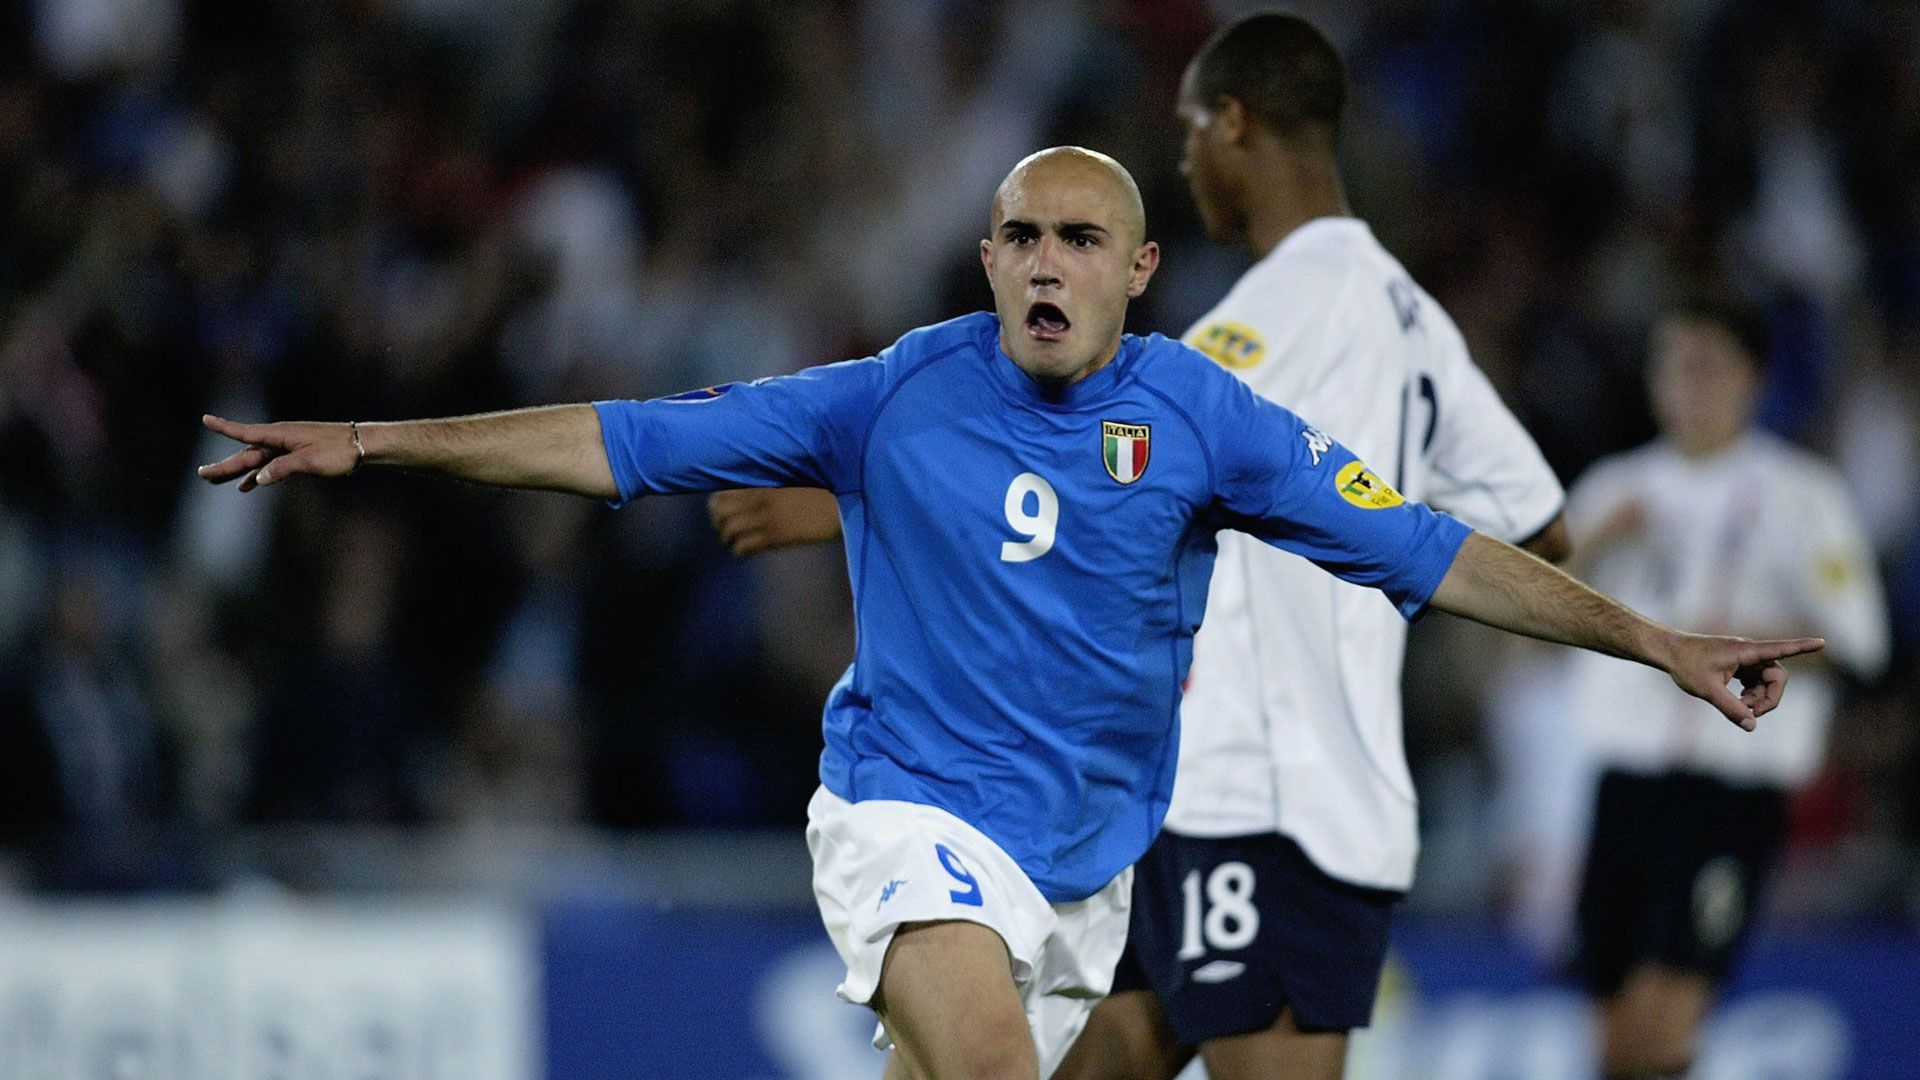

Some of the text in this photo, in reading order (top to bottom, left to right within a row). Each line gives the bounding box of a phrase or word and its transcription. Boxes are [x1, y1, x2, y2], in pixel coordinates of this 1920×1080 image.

[1106, 424, 1145, 438] ITALIA
[1000, 472, 1059, 562] 9
[935, 843, 983, 907] 9
[1178, 861, 1260, 959] 18
